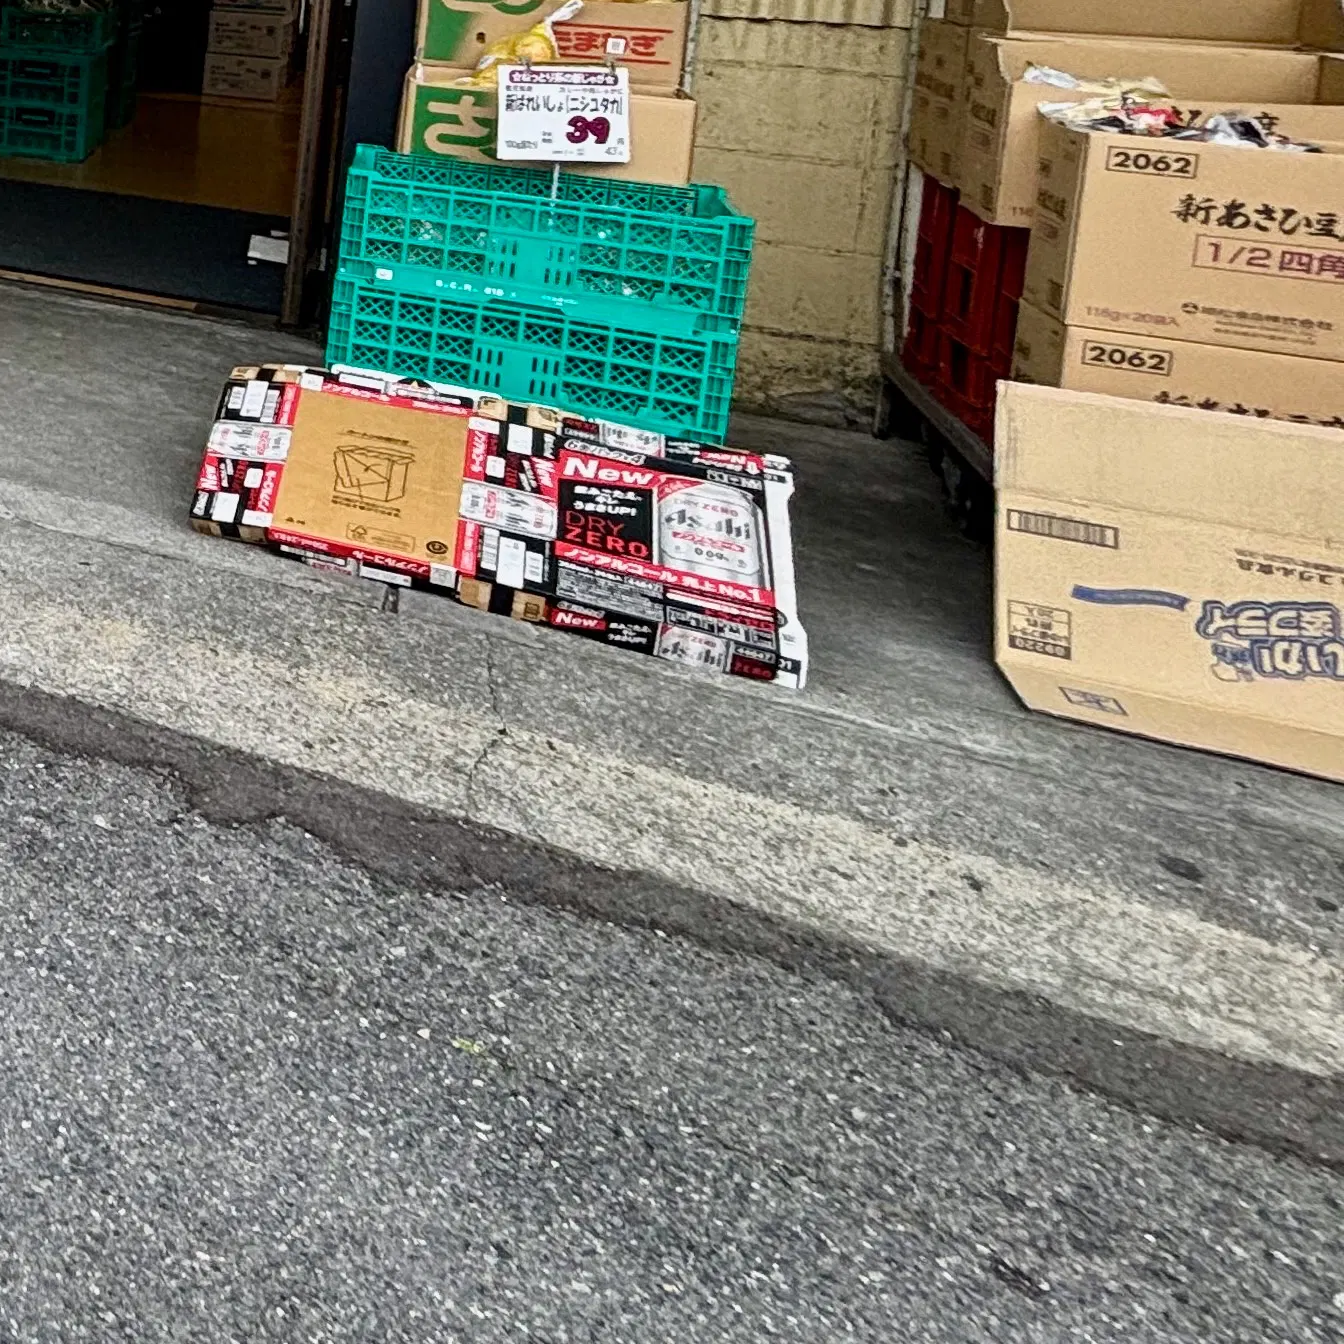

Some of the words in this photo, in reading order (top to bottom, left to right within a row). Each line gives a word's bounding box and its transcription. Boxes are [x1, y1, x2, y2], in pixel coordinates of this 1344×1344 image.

[566, 115, 611, 145] 39
[1113, 151, 1193, 175] 2062
[1170, 193, 1344, 243] 新あさひ豆
[1089, 345, 1166, 372] 2062
[563, 456, 655, 485] New
[565, 511, 626, 537] DRY
[564, 524, 649, 557] ZERO
[563, 548, 678, 584] ノンアルコール
[554, 611, 601, 629] New
